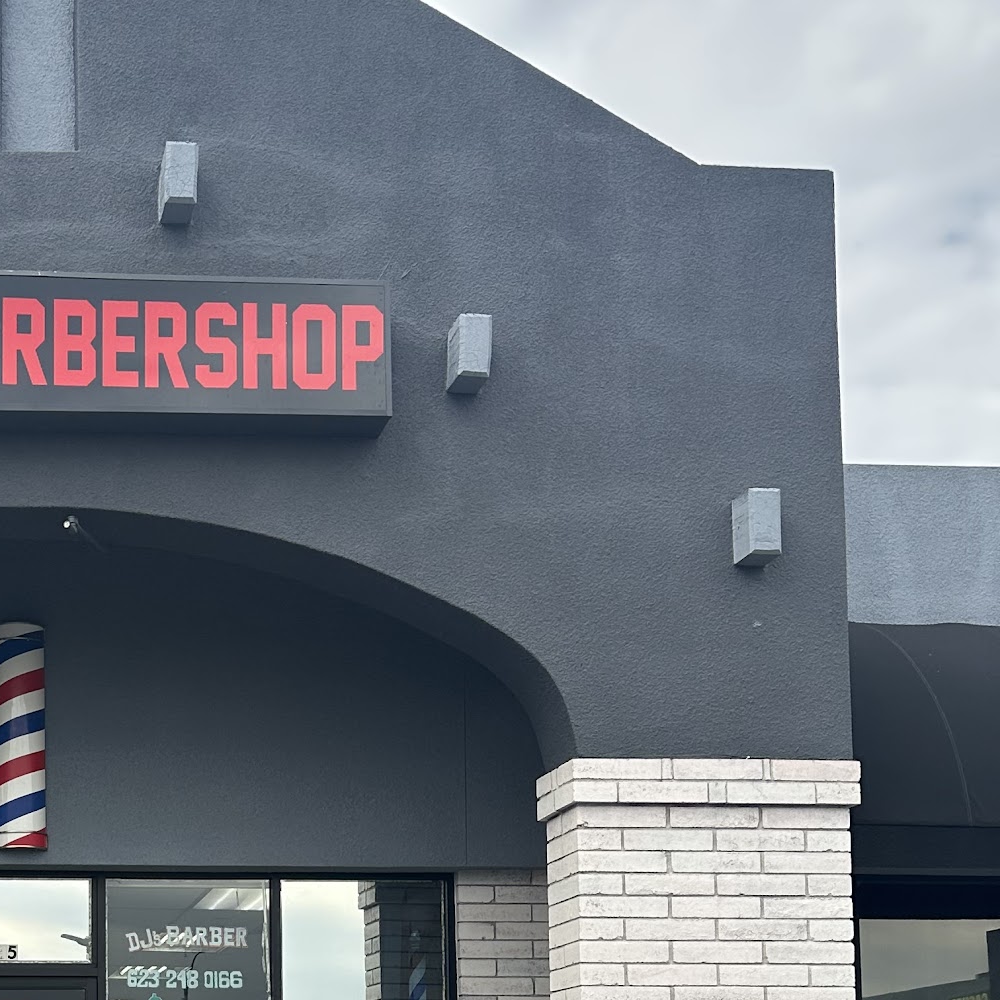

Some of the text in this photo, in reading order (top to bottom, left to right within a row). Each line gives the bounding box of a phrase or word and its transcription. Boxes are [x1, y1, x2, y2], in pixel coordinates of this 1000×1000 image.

[165, 925, 248, 948] BARBER
[8, 945, 17, 959] 5
[127, 969, 243, 989] 623 248 0166
